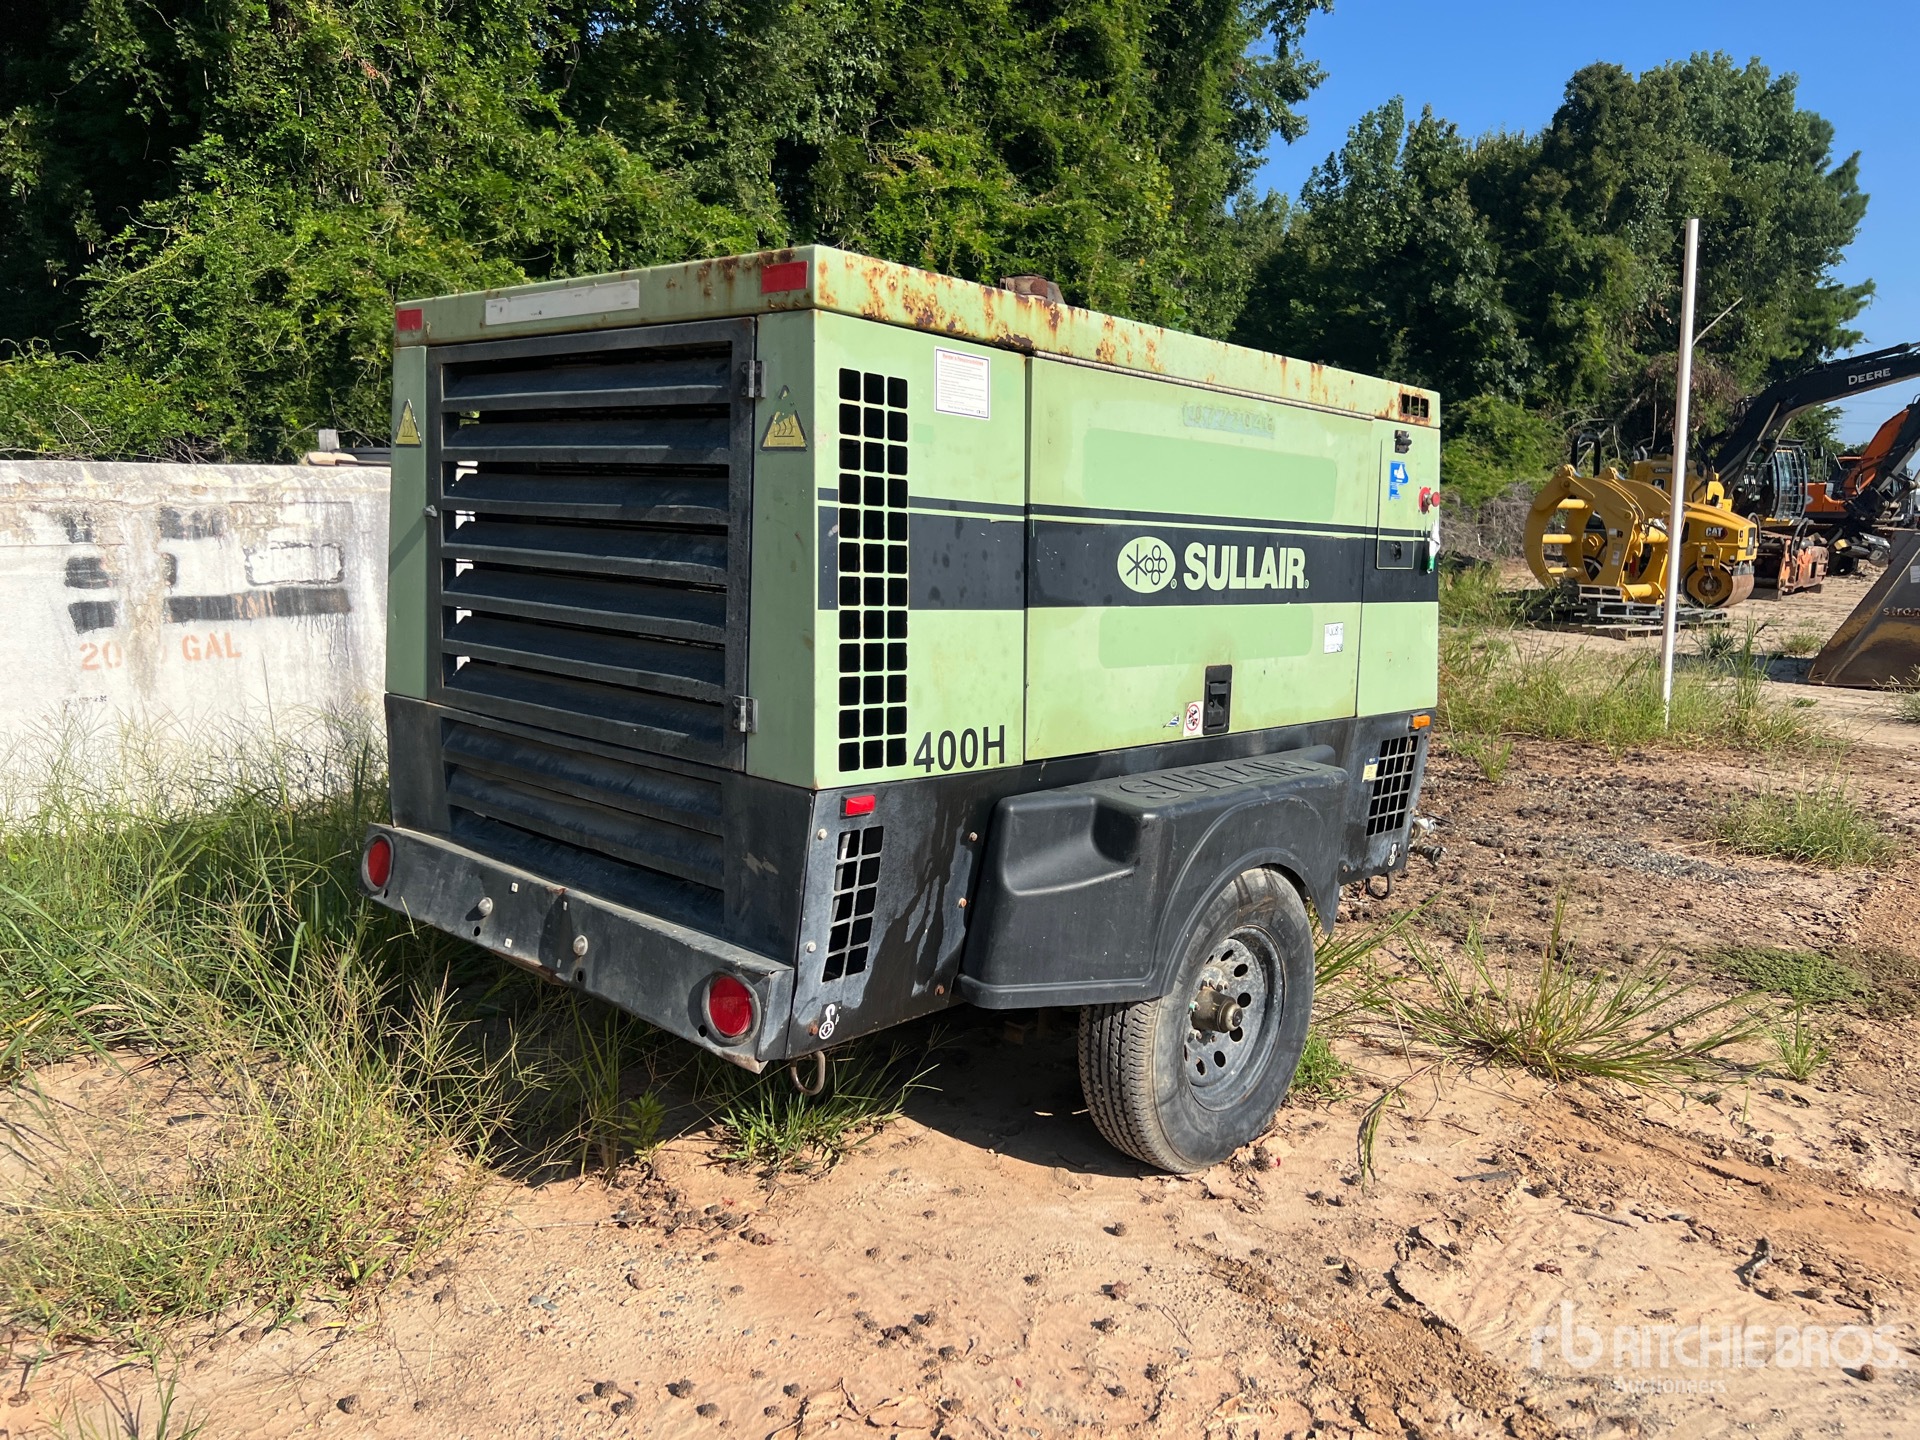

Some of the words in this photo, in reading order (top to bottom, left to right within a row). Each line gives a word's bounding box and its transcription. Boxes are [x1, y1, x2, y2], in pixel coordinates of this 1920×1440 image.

[1848, 368, 1891, 385] DEERE
[1705, 527, 1723, 538] CAT
[1183, 541, 1306, 591] SULLAIR
[181, 632, 242, 662] GAL
[913, 725, 1005, 773] 400H
[1119, 760, 1320, 799] SULLAIR
